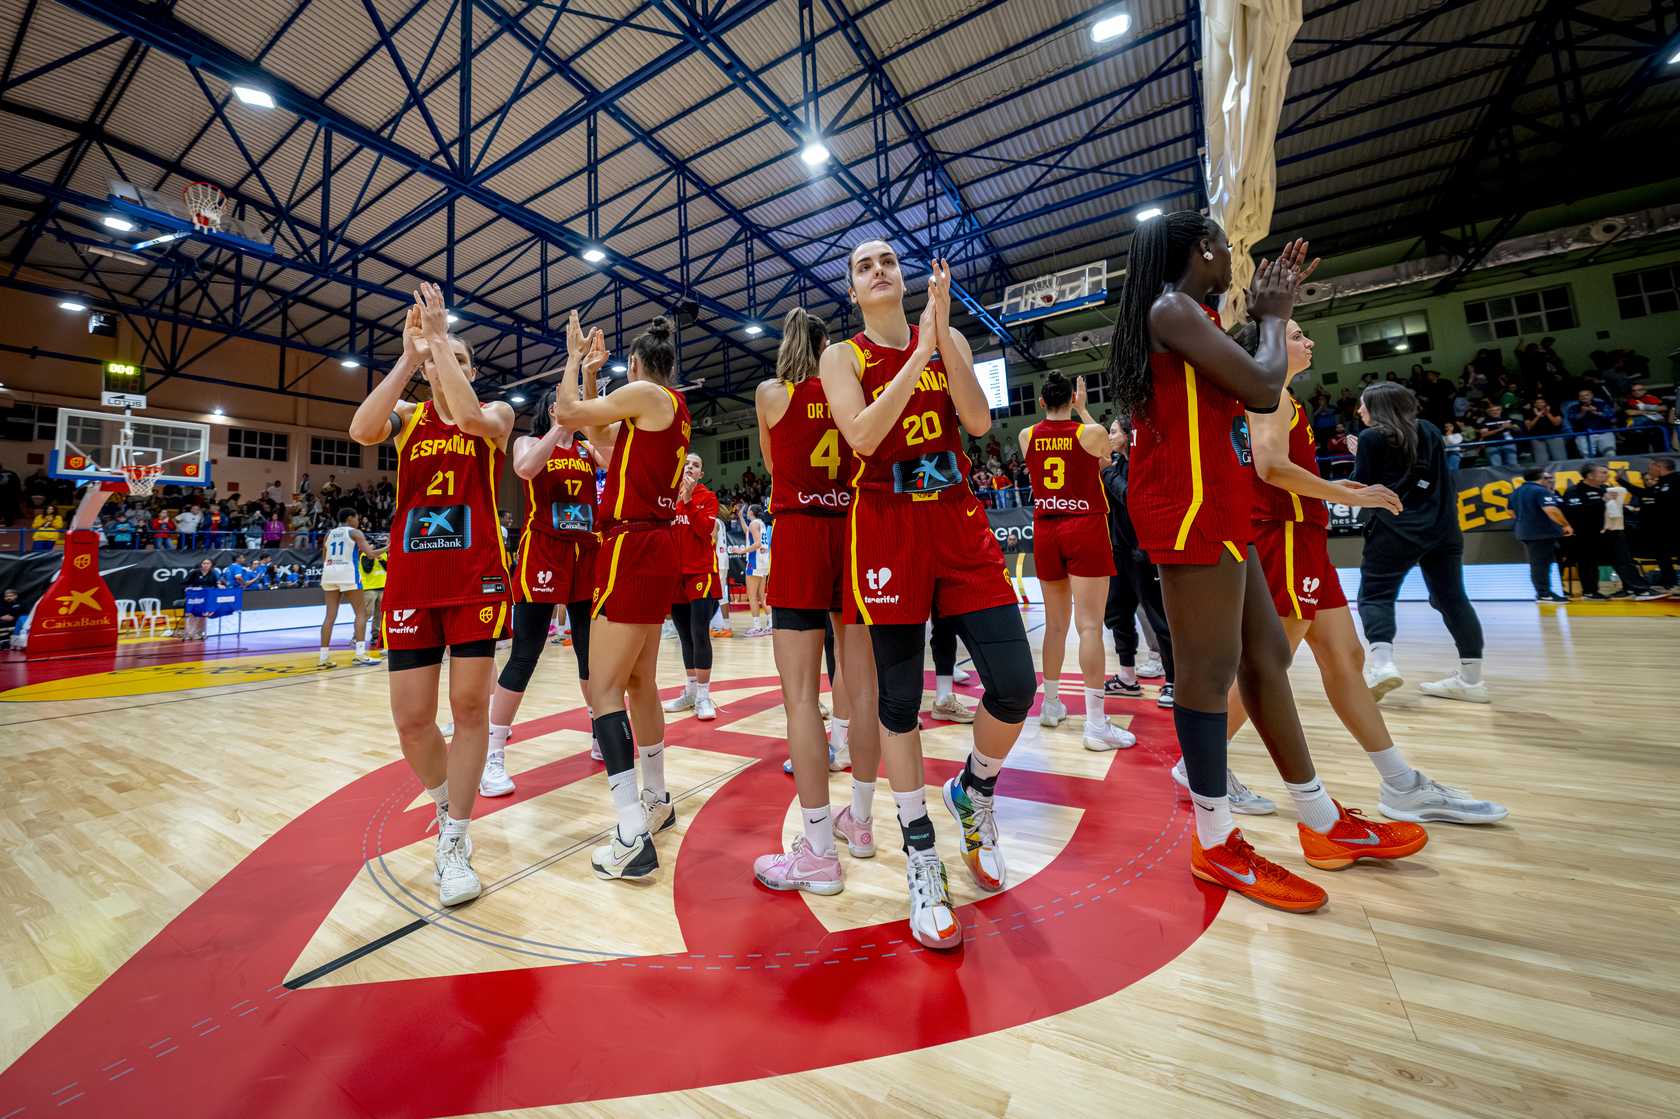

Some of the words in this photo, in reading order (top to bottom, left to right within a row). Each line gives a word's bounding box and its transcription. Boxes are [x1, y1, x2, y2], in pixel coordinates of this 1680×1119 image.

[807, 403, 831, 419] ORT
[902, 410, 943, 446] 20
[410, 433, 477, 461] ESPAÑA
[1035, 438, 1073, 451] ETXARRI
[810, 429, 841, 480] 4
[546, 458, 594, 476] ESPAÑA
[1043, 457, 1065, 490] 3
[426, 470, 455, 496] 21
[564, 479, 583, 496] 17
[798, 488, 851, 507] ende
[329, 541, 345, 556] 11
[410, 538, 462, 550] CaixaBank
[41, 616, 111, 629] CaixaBank
